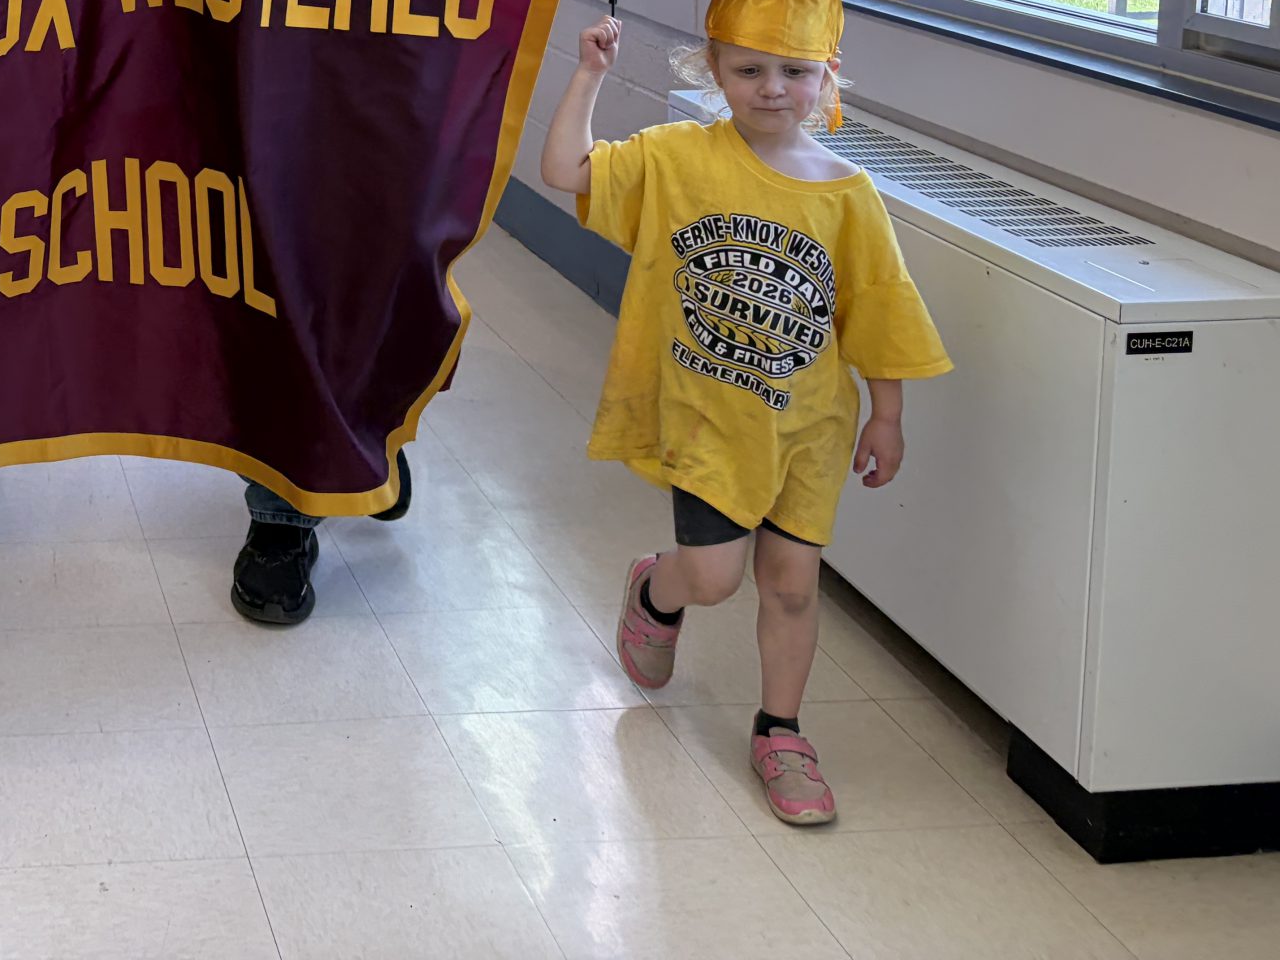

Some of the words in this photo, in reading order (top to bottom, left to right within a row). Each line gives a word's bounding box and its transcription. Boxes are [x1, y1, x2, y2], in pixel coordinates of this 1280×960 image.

[672, 215, 787, 257] BERNE-KNOX
[704, 251, 775, 274] FIELD
[784, 268, 823, 308] DAY
[733, 271, 792, 305] 2026
[694, 281, 824, 349] SURVIVED
[688, 315, 713, 346] FUN
[714, 342, 728, 356] &
[733, 348, 794, 373] FITNESS
[1130, 337, 1190, 349] CUH-E-C21A
